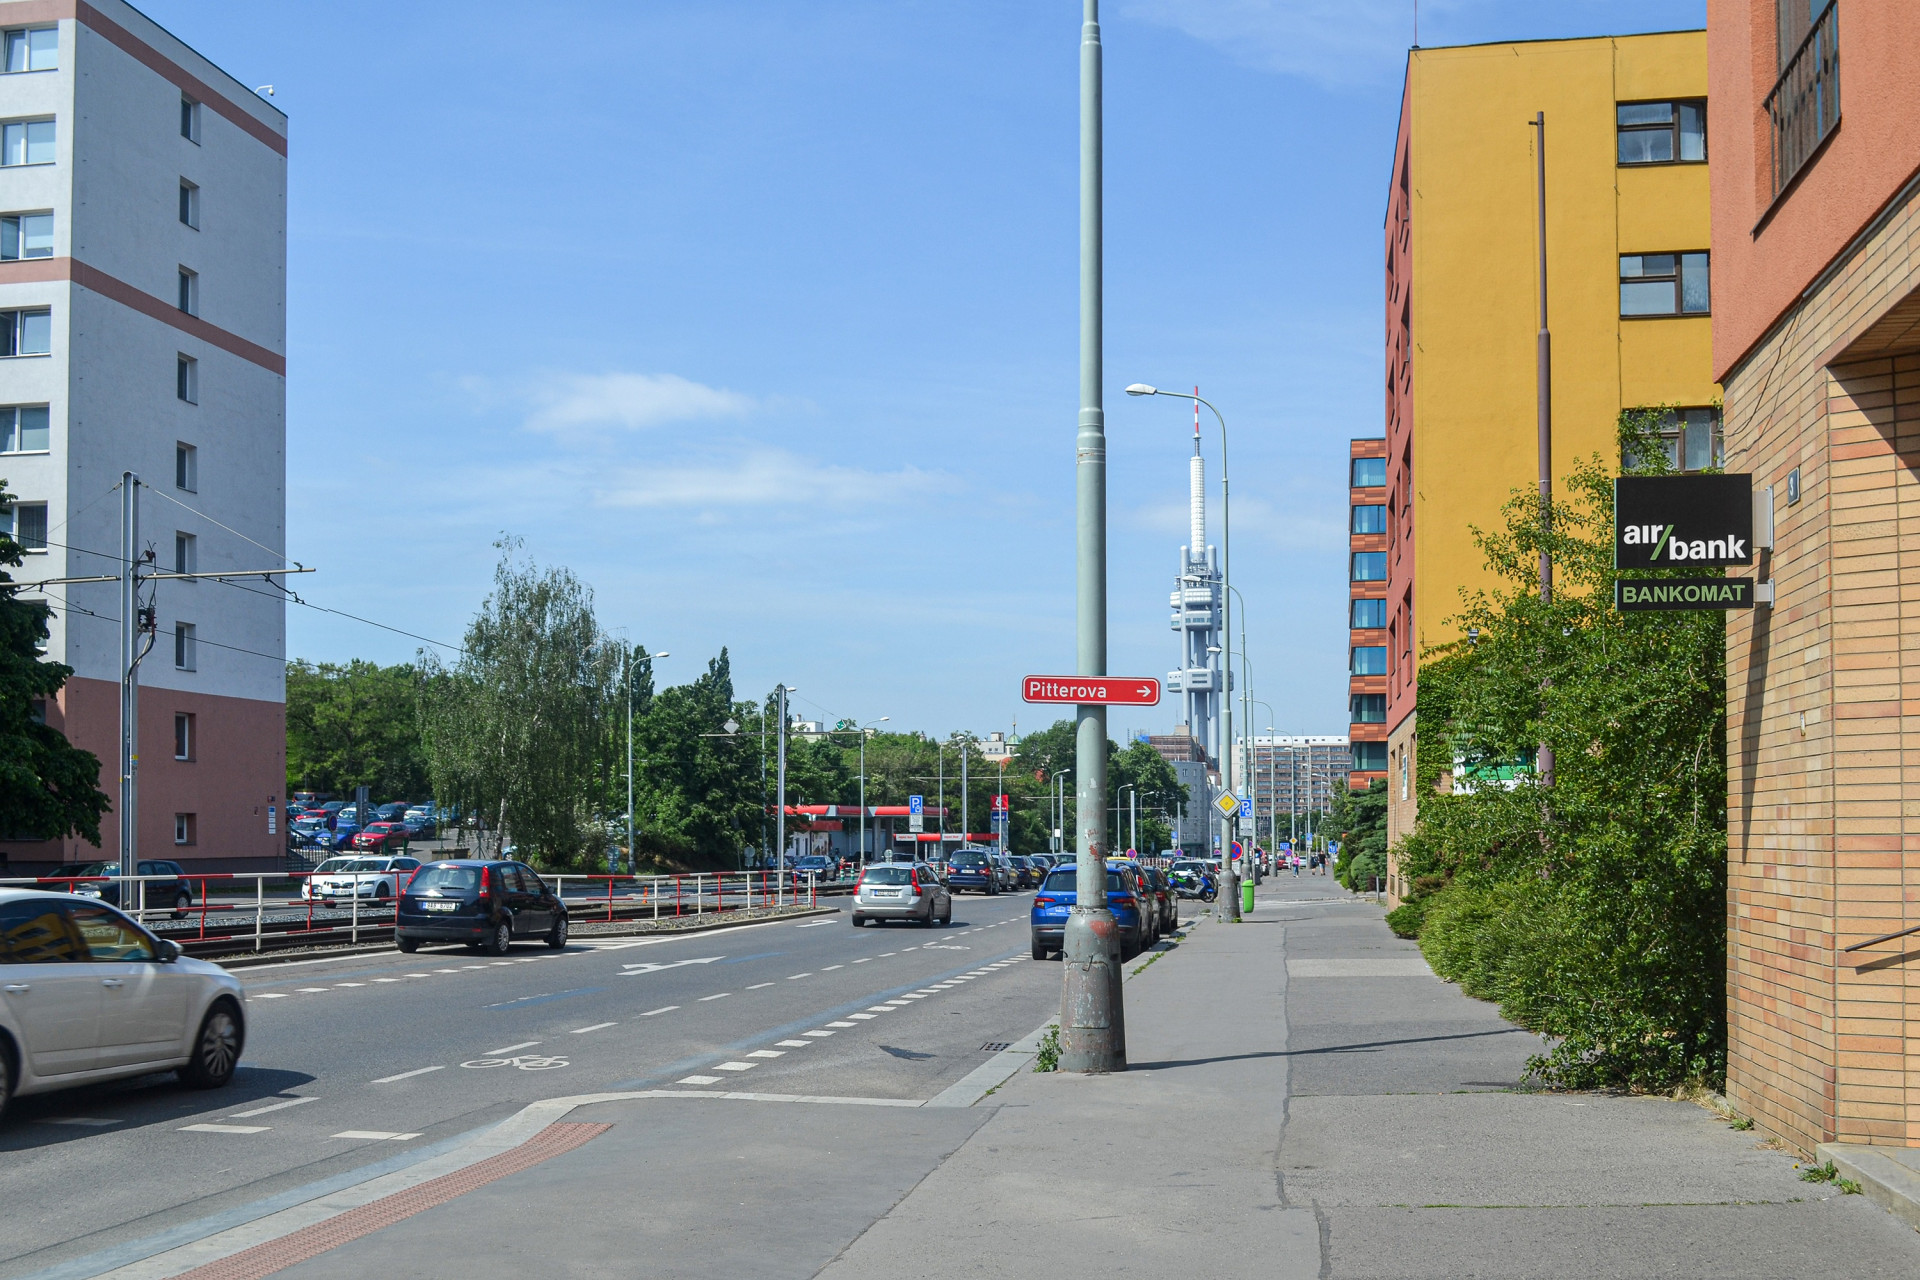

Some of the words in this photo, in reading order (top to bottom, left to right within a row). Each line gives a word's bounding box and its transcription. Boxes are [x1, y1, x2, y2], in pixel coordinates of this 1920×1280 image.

[1669, 534, 1746, 560] bank
[1622, 584, 1746, 603] BANKOMAT
[1029, 681, 1107, 698] Pitterova
